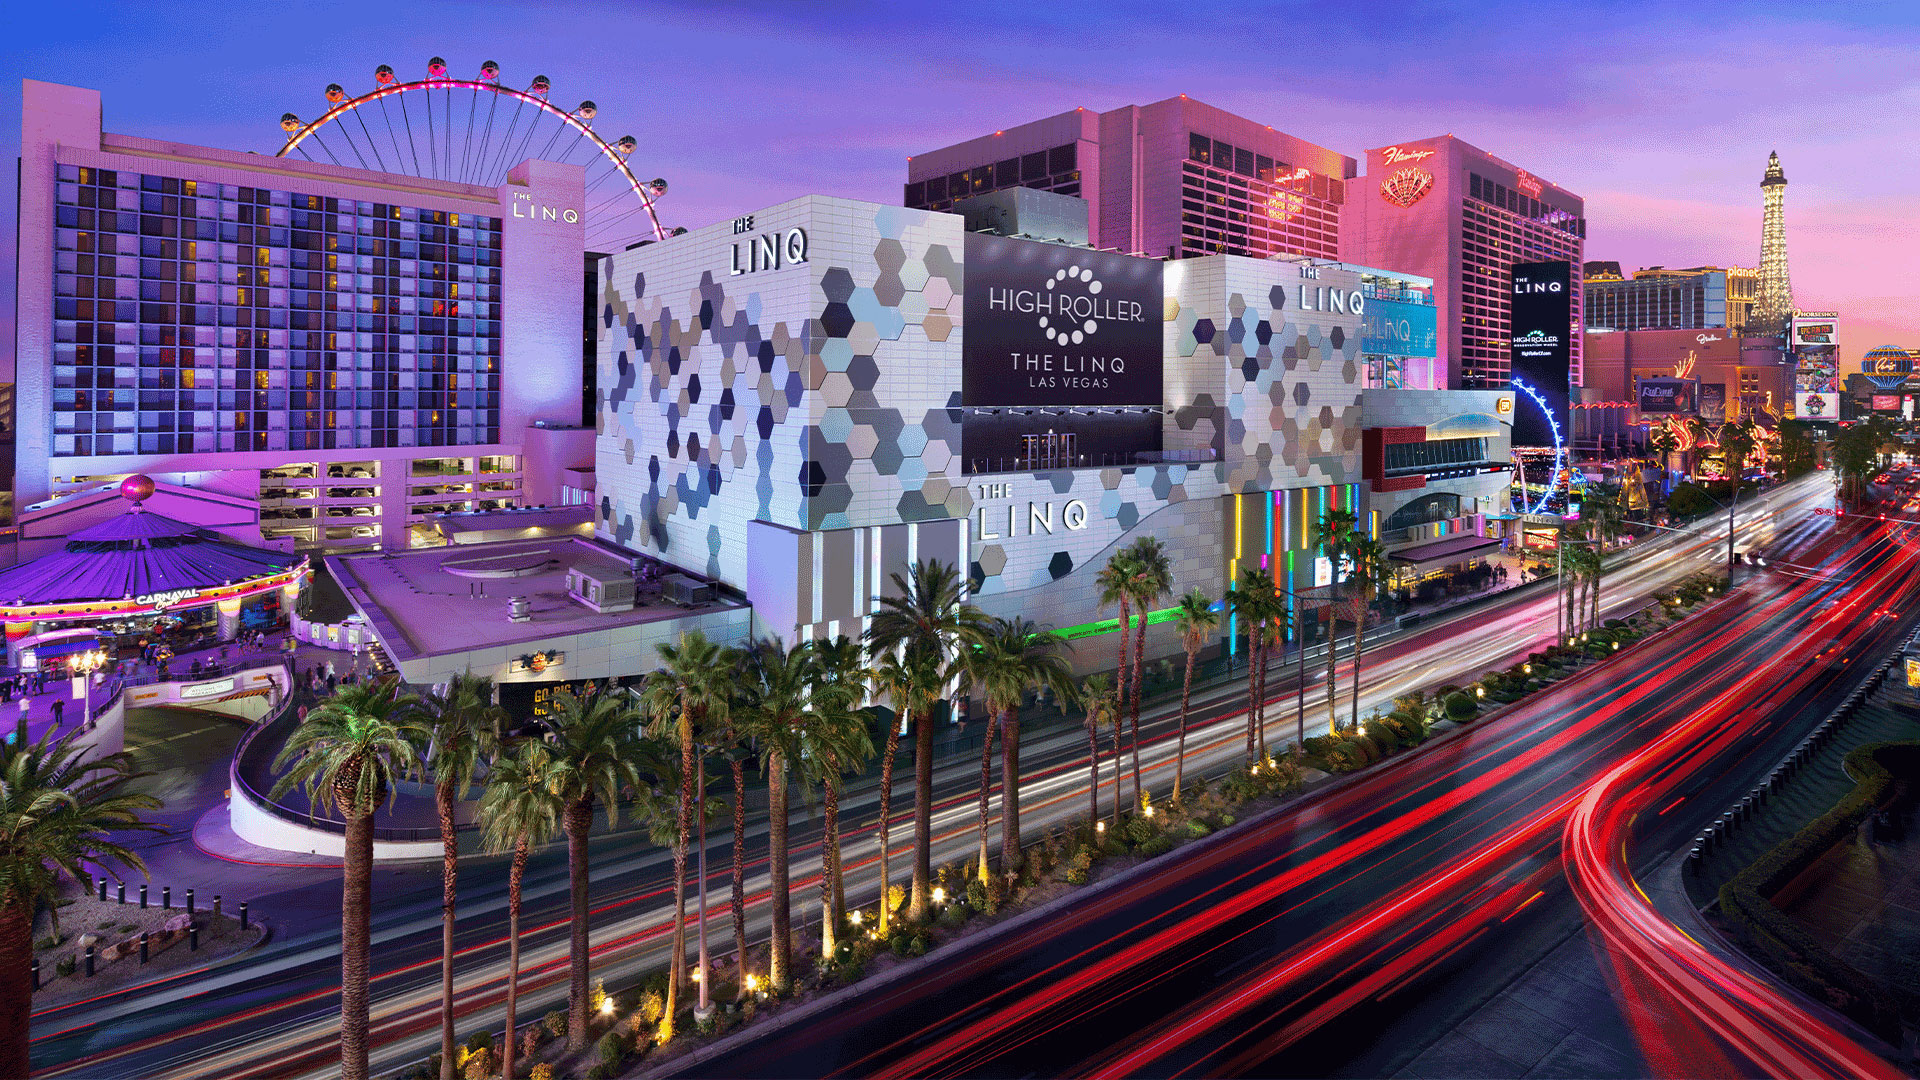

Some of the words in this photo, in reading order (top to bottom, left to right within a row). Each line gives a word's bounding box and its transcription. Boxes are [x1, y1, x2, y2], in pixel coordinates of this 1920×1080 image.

[1383, 147, 1434, 165] Flamingo
[1518, 169, 1542, 197] Flamingo
[513, 192, 531, 201] THE
[513, 202, 579, 224] LINQ
[731, 216, 754, 235] THE
[730, 228, 808, 276] LINQ
[1301, 267, 1320, 280] THE
[1727, 264, 1758, 279] planet
[1515, 282, 1561, 293] LINQ
[990, 287, 1052, 314] HIGH
[1060, 294, 1143, 324] ROLLER
[1300, 286, 1364, 315] LINQ
[1376, 314, 1410, 341] LINQ
[1531, 336, 1558, 344] ROLLER
[1011, 353, 1054, 371] THE
[1064, 355, 1125, 374] LINQ
[1876, 357, 1896, 375] Paris
[1029, 376, 1056, 388] LAS
[1062, 377, 1109, 389] VEGAS
[980, 484, 1012, 499] THE
[979, 499, 1088, 540] LINQ
[136, 589, 199, 605] CARNAVAL
